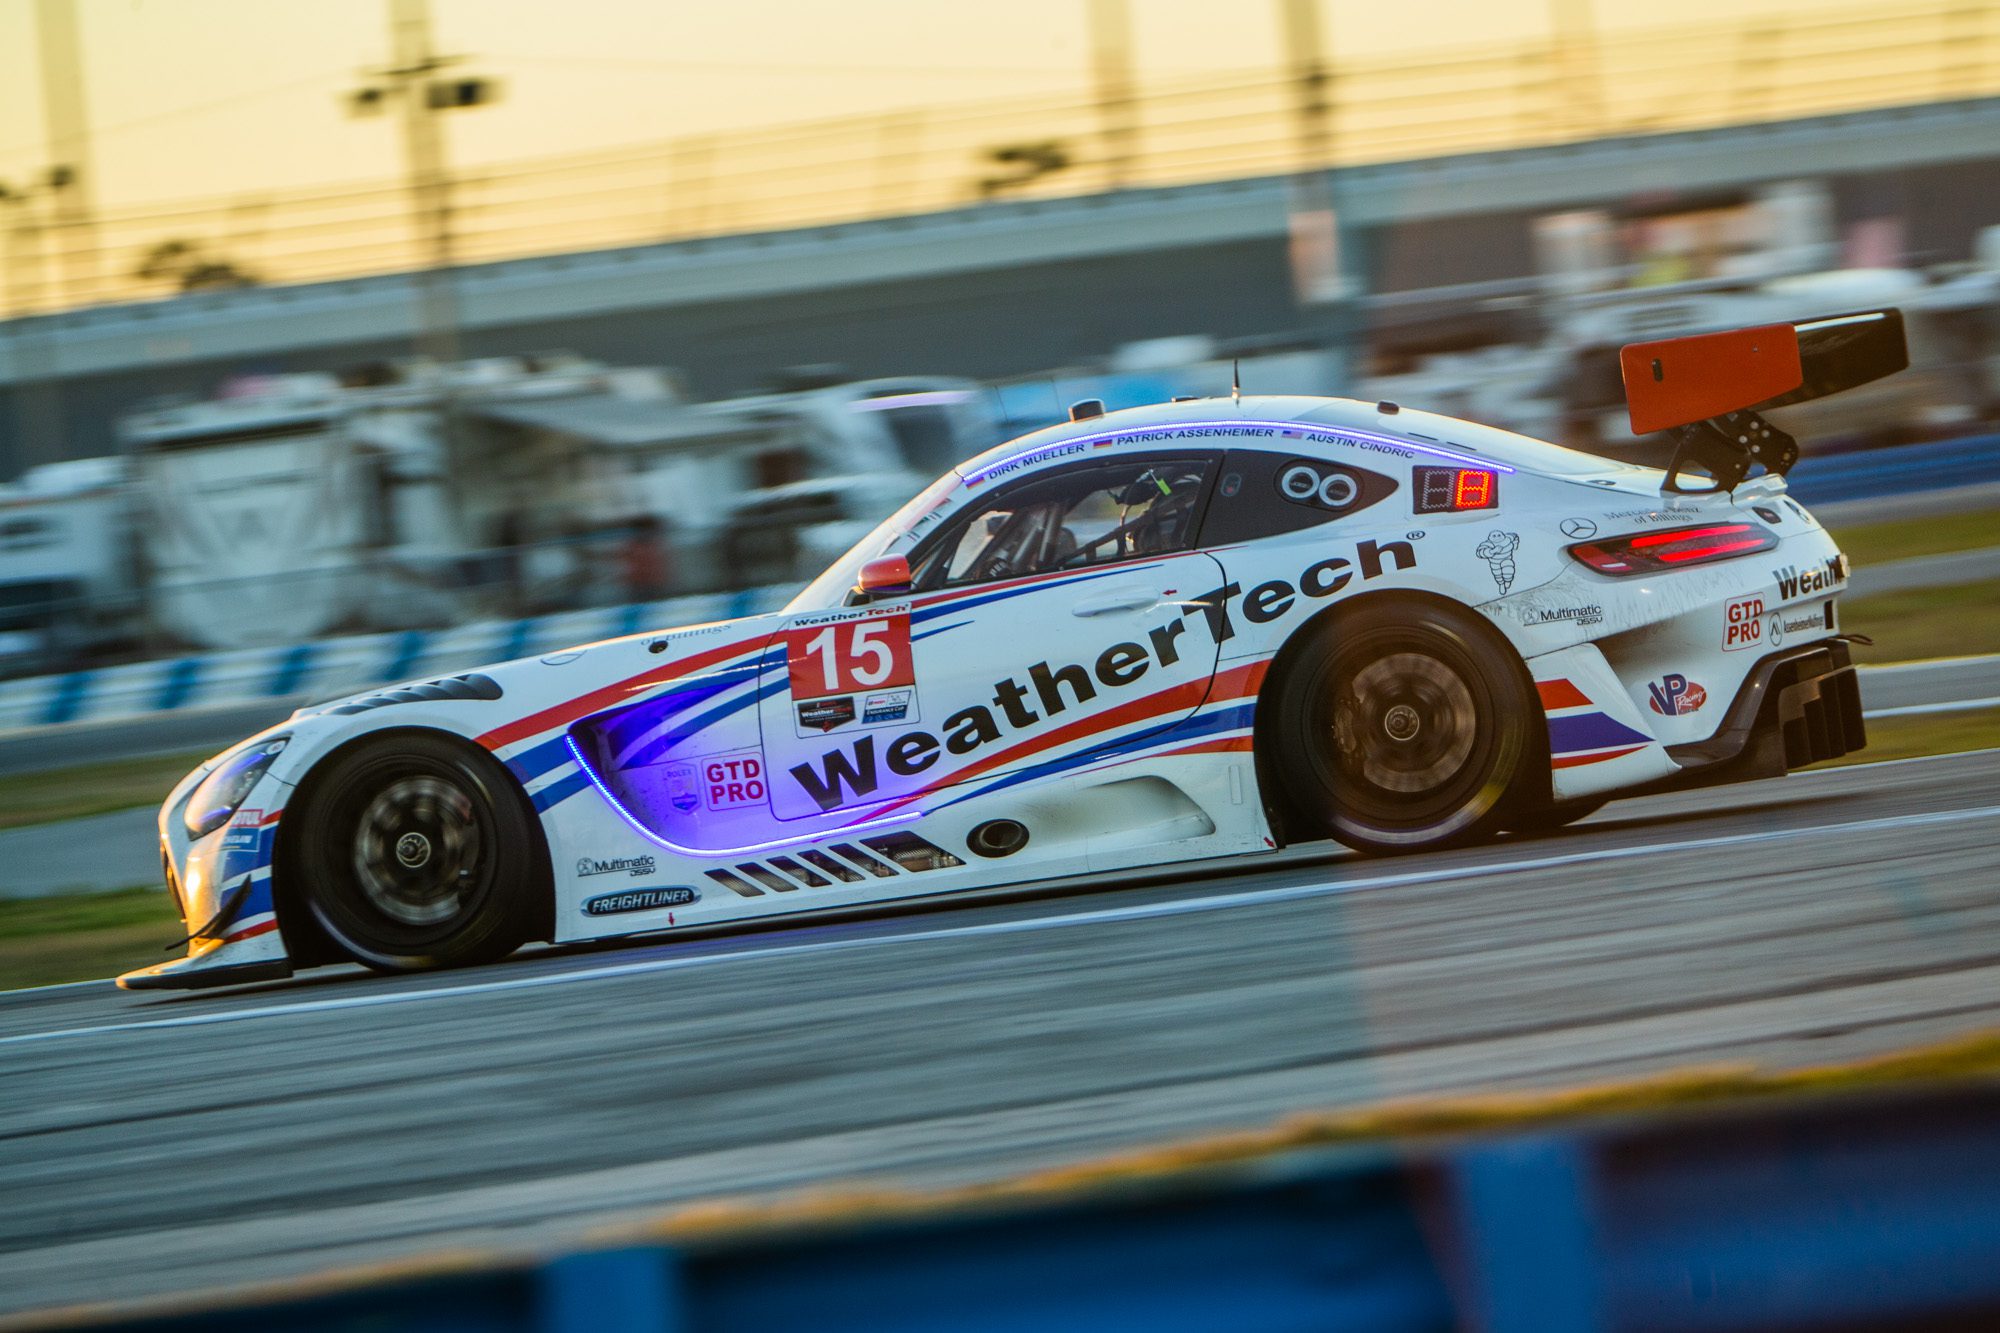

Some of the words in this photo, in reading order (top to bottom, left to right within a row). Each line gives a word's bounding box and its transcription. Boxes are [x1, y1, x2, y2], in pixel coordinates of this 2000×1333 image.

[1117, 430, 1173, 446] PATRICK
[1175, 428, 1274, 441] ASSENHEIMER
[1306, 433, 1357, 448] AUSTIN
[1360, 441, 1415, 459] CINDRIC
[989, 463, 1020, 480] DIRK
[1023, 444, 1085, 465] MUELLER
[1540, 603, 1602, 621] Multimatic
[1728, 599, 1764, 624] GTD
[1727, 619, 1761, 646] PRO
[806, 619, 893, 691] 15
[1647, 673, 1688, 716] VP
[706, 759, 760, 783] GTD
[710, 780, 764, 805] PRO
[594, 855, 655, 873] Multimatic
[592, 889, 690, 913] FREIGHTLINER
